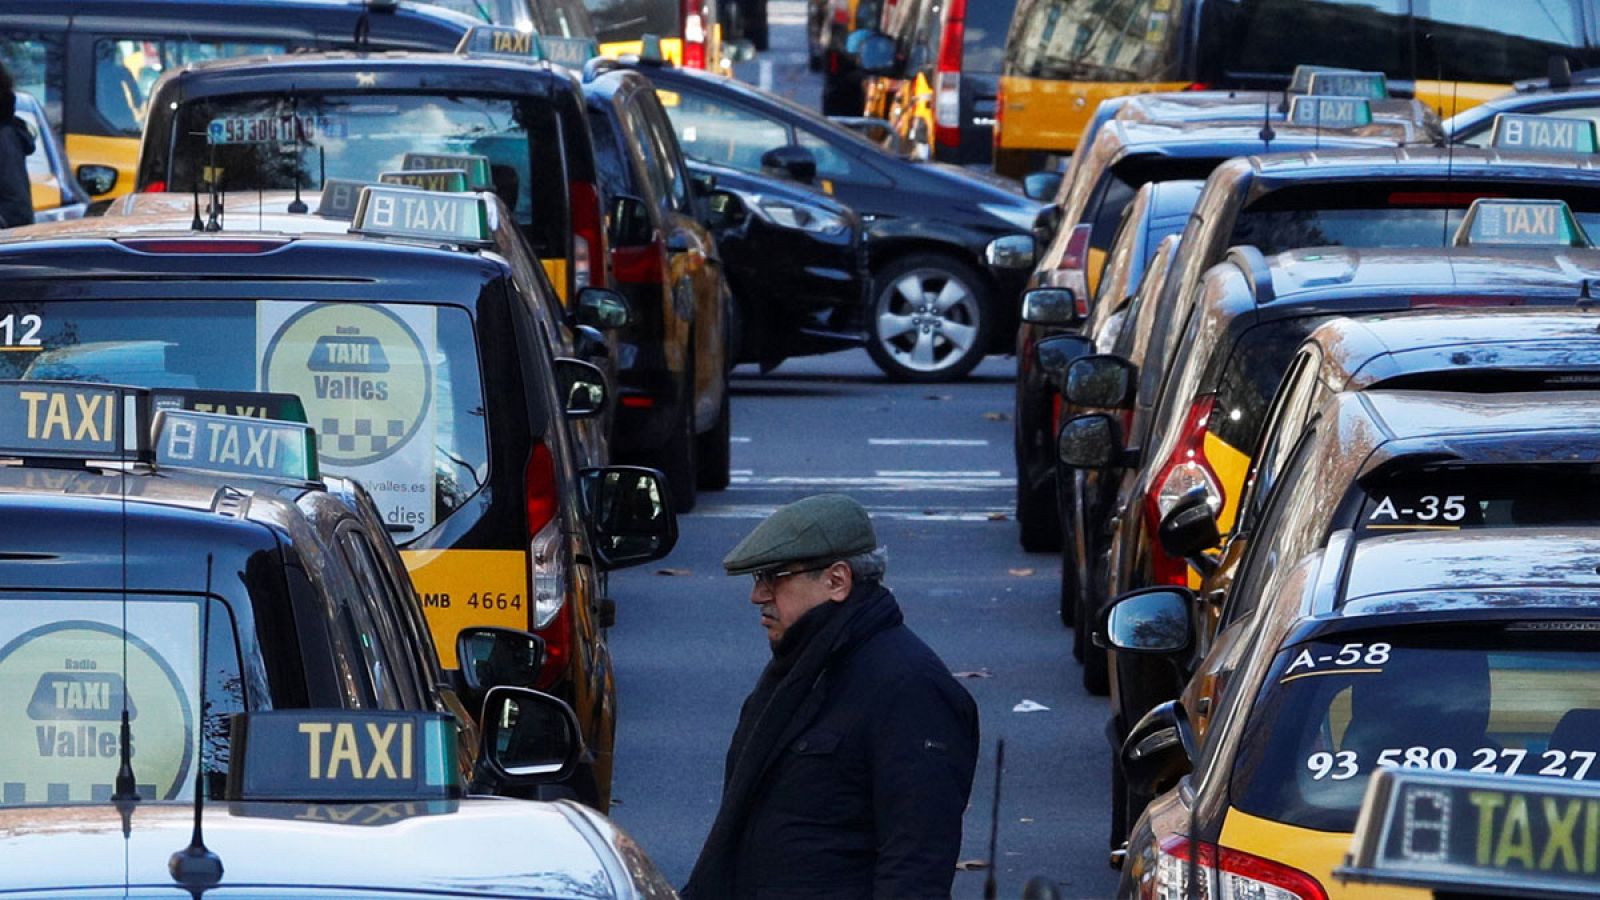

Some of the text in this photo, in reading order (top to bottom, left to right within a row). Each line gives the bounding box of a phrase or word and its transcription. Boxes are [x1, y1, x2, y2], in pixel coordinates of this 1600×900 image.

[493, 32, 530, 52] TAXI
[1320, 101, 1353, 121] TAXI
[1527, 121, 1573, 148] TAXI
[401, 198, 457, 233] TAXI
[1503, 206, 1555, 235] TAXI
[326, 343, 370, 364] TAXI
[313, 375, 389, 400] Valles
[20, 391, 113, 442] TAXI
[207, 423, 279, 468] TAXI
[387, 505, 425, 524] dies
[1369, 495, 1466, 521] A-35
[419, 592, 521, 610] MB 4664
[65, 658, 97, 670] Radio
[1285, 642, 1392, 674] A-58
[52, 681, 110, 710] TAXI
[298, 722, 413, 780] TAXI
[1307, 746, 1597, 781] 93 580 27 27
[1469, 791, 1600, 874] TAXI
